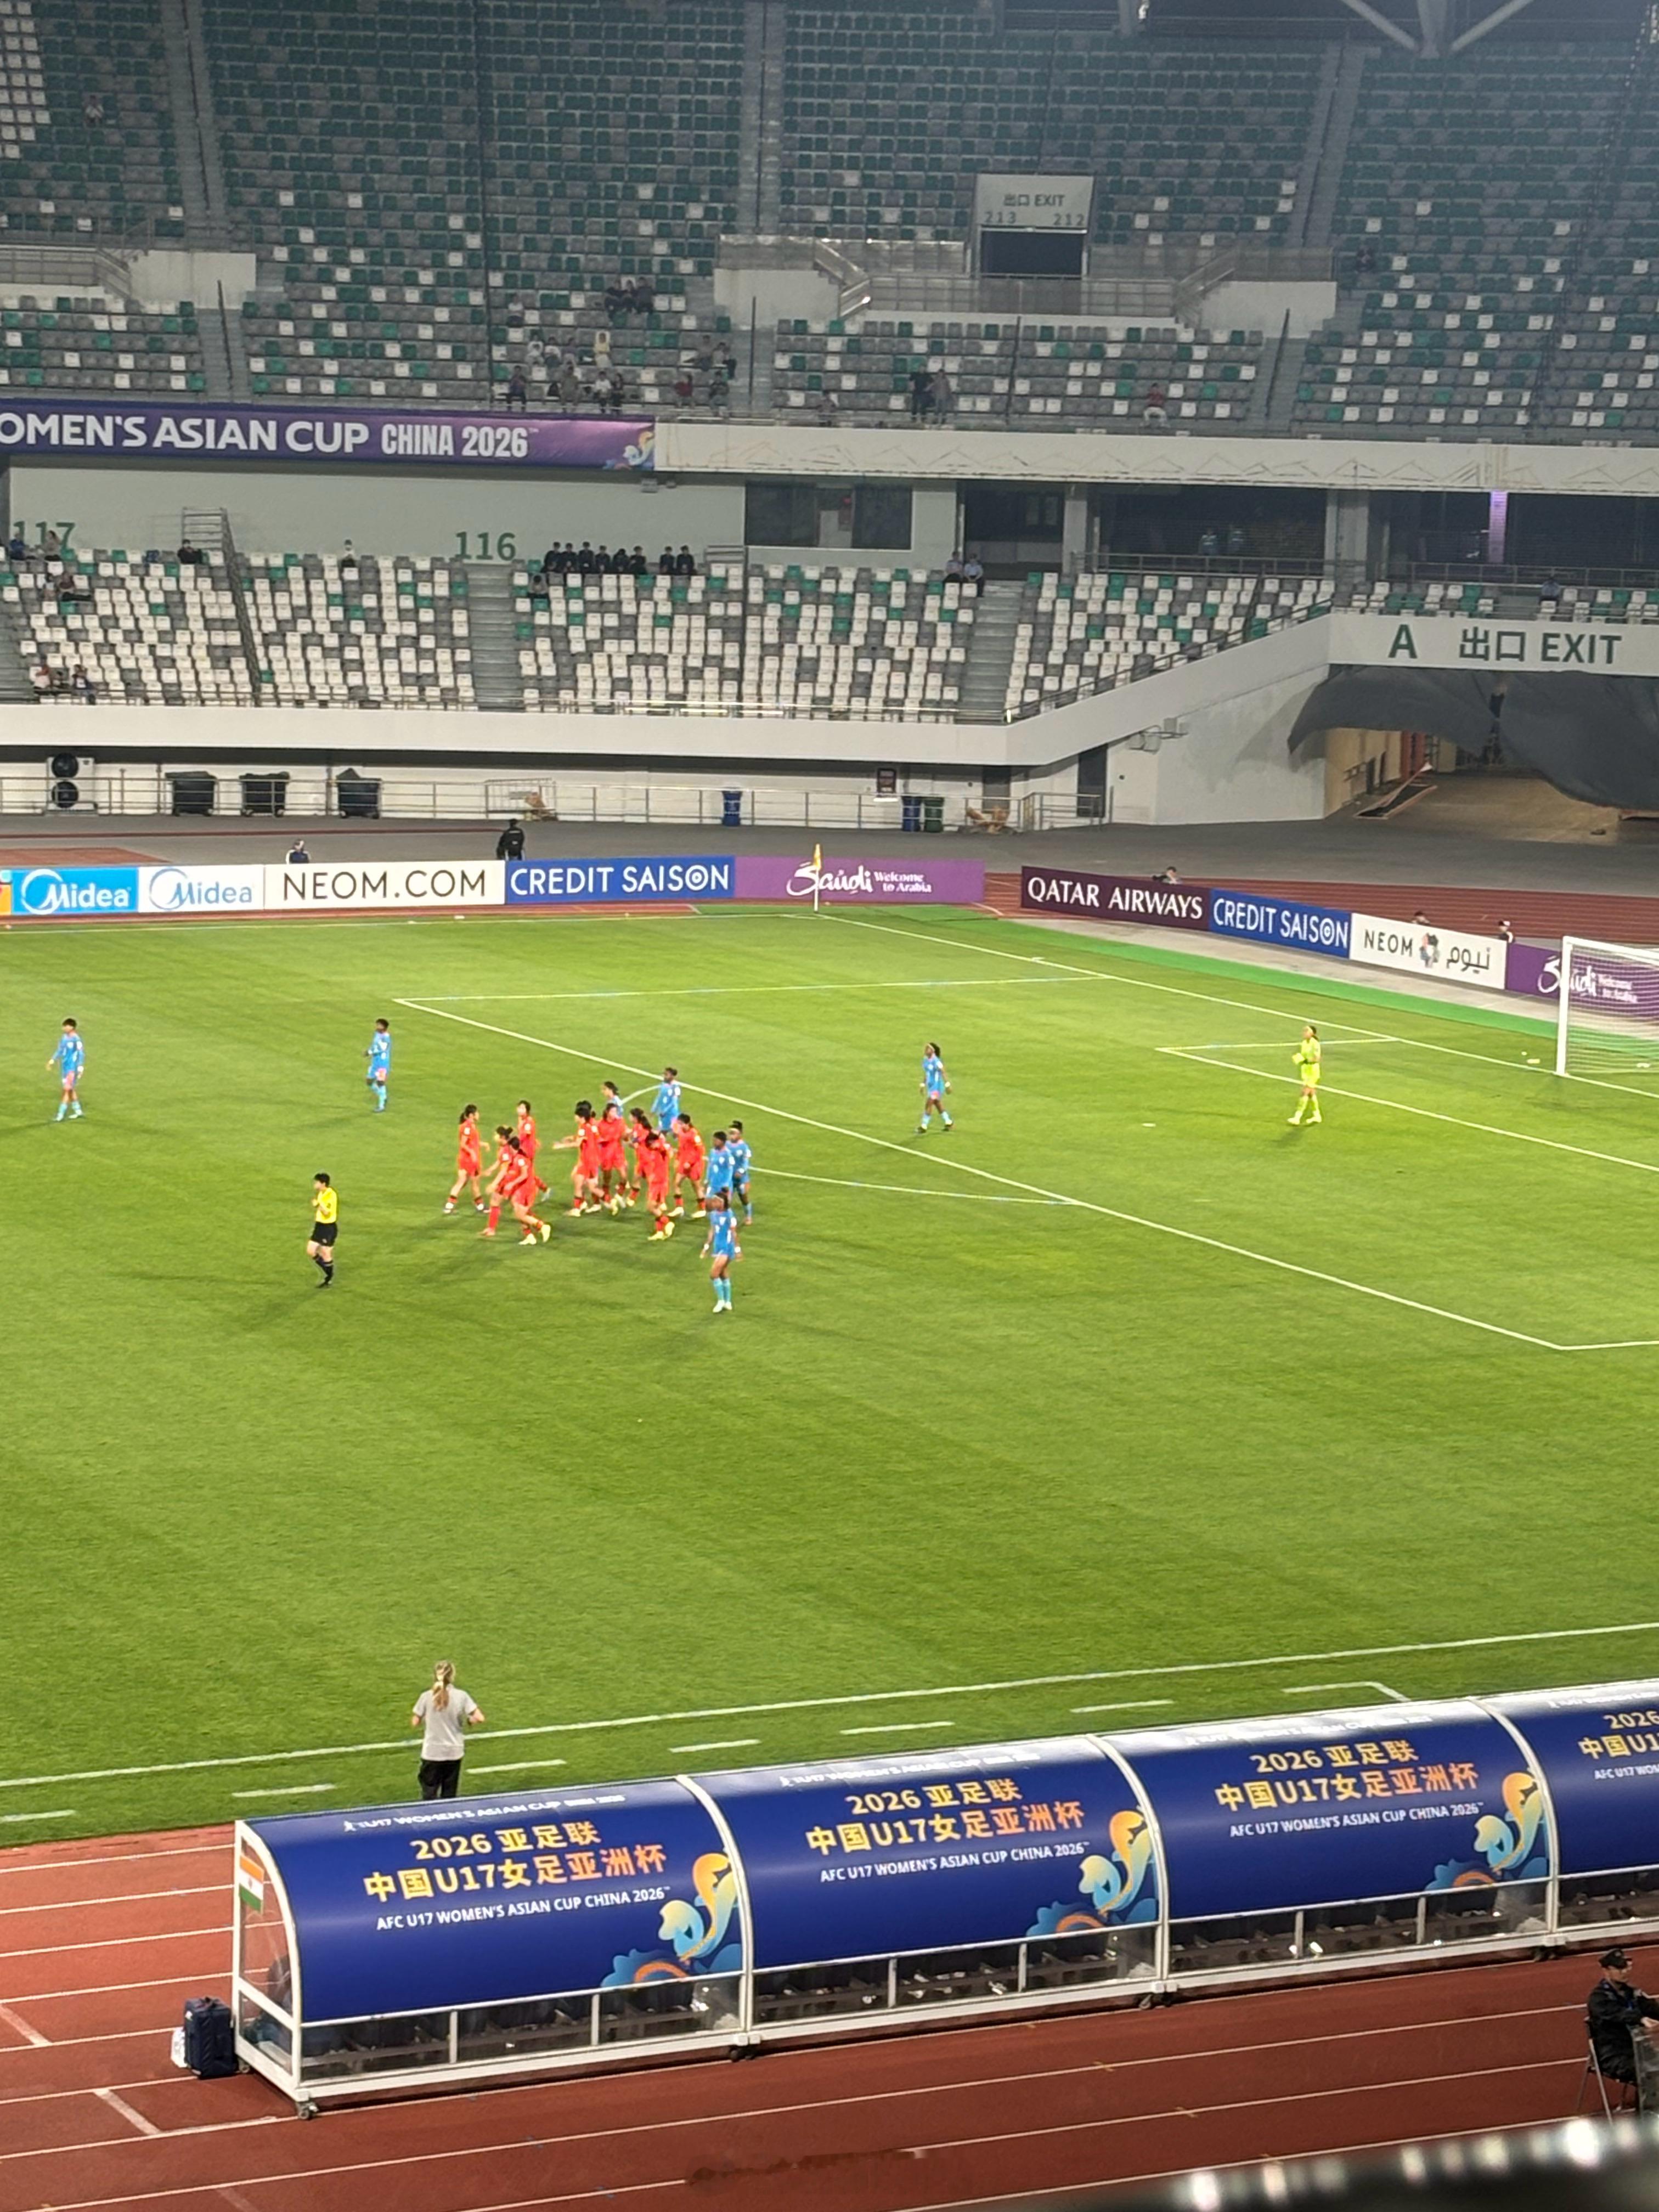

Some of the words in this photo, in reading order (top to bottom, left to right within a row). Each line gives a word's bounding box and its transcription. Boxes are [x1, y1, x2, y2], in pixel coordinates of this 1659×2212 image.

[1003, 194, 1030, 207] 出口
[1034, 194, 1065, 207] EXIT
[985, 211, 1017, 224] 213
[1053, 213, 1085, 225] 212
[153, 417, 278, 452] ASIAN
[285, 421, 370, 453] CUP
[381, 423, 454, 456] CHINA
[13, 521, 76, 550] 117
[455, 531, 517, 561] 116
[1389, 624, 1417, 659] A
[1459, 626, 1526, 662] 出口
[1541, 632, 1622, 664] EXIT
[283, 869, 486, 901] NEOM.COM
[510, 867, 614, 896] CREDIT
[621, 864, 730, 893] SAISON
[874, 871, 924, 883] Welcome
[882, 883, 895, 893] to
[896, 882, 932, 894] Arabia
[21, 883, 131, 915] Midea
[150, 881, 252, 910] Midea
[1027, 876, 1101, 908] QATAR
[1108, 887, 1204, 920] AIRWAYS
[1212, 897, 1277, 935] CREDIT
[1279, 910, 1348, 949] SAISON
[1364, 928, 1414, 957] NEOM
[1446, 946, 1491, 973] نيوم
[1249, 1750, 1323, 1774] 2026
[1323, 1739, 1420, 1768] 亚足联
[1577, 1732, 1659, 1760] 中国U1
[1214, 1762, 1480, 1813] 中国U17女足亚洲杯
[1594, 1768, 1615, 1780] AFC
[1615, 1766, 1635, 1778] U17
[845, 1788, 921, 1815] 2026
[926, 1777, 1022, 1808] 亚足联
[805, 1800, 1086, 1857] 中国U17女足亚洲杯
[1229, 1824, 1255, 1838] AFC
[1255, 1822, 1279, 1836] U17
[1280, 1815, 1341, 1833] WOMEN'S
[1342, 1812, 1381, 1827] ASIAN
[1381, 1809, 1407, 1824] CUP
[1408, 1805, 1450, 1820] CHINA
[410, 1833, 492, 1860] 2026
[494, 1820, 602, 1853] 亚足联
[363, 1844, 668, 1903] 中国U17女足亚洲杯
[820, 1867, 846, 1883] AFC
[848, 1865, 873, 1881] U17
[875, 1858, 938, 1877] WOMEN'S
[940, 1853, 980, 1869] ASIAN
[981, 1849, 1008, 1865] CUP
[1010, 1844, 1054, 1861] CHINA
[376, 1914, 404, 1931] AFC
[407, 1912, 434, 1927] U17
[436, 1904, 505, 1925] WOMEN'S
[507, 1899, 551, 1917] ASIAN
[554, 1896, 582, 1912] CUP
[584, 1891, 631, 1910] CHINA
